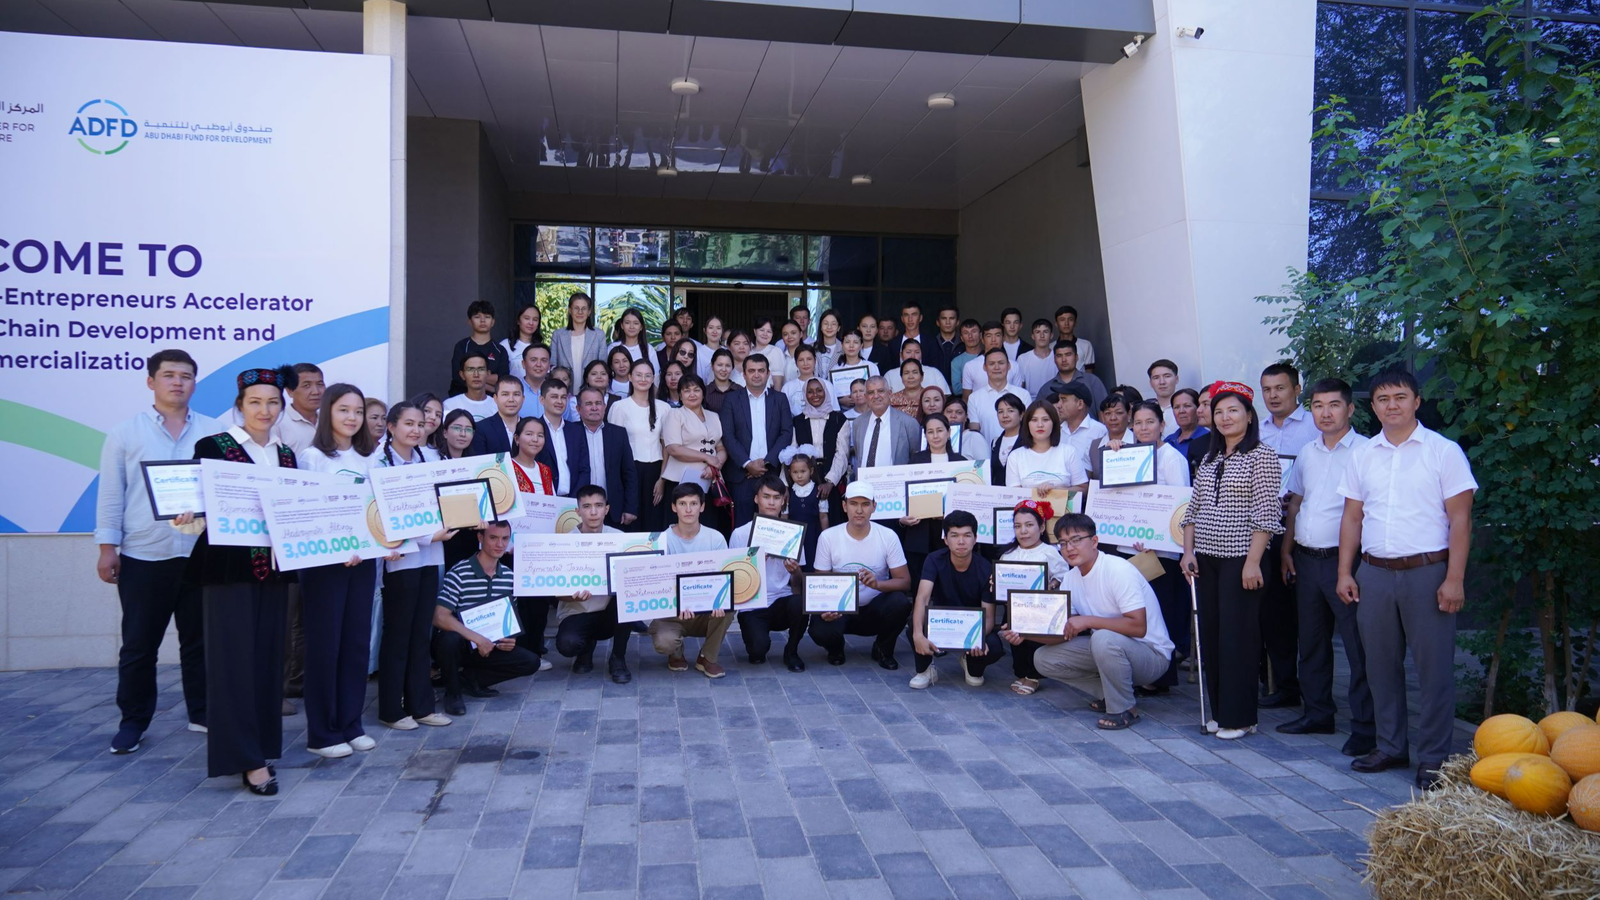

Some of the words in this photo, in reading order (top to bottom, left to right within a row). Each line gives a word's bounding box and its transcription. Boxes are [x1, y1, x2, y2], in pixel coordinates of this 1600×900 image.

[0, 122, 9, 130] R
[13, 123, 35, 132] FOR
[68, 116, 138, 137] ADFD
[144, 131, 160, 139] ABU
[161, 132, 184, 140] DHABI
[185, 133, 204, 141] FUND
[206, 134, 220, 142] FOR
[221, 135, 272, 144] DEVELOPMENT
[138, 243, 203, 278] TO
[0, 288, 177, 311] Entrepreneurs
[183, 292, 313, 312] Accelerator
[69, 321, 226, 344] Development
[233, 324, 275, 342] and
[1105, 456, 1136, 464] Certificate
[154, 475, 198, 485] Certificate
[757, 524, 786, 535] Certificate
[282, 535, 360, 559] 3,000,000
[521, 574, 602, 588] 3,000,000
[682, 583, 713, 591] Certificate
[1012, 601, 1048, 609] Certificate
[465, 610, 497, 626] Certificate
[929, 616, 964, 625] Certificate
